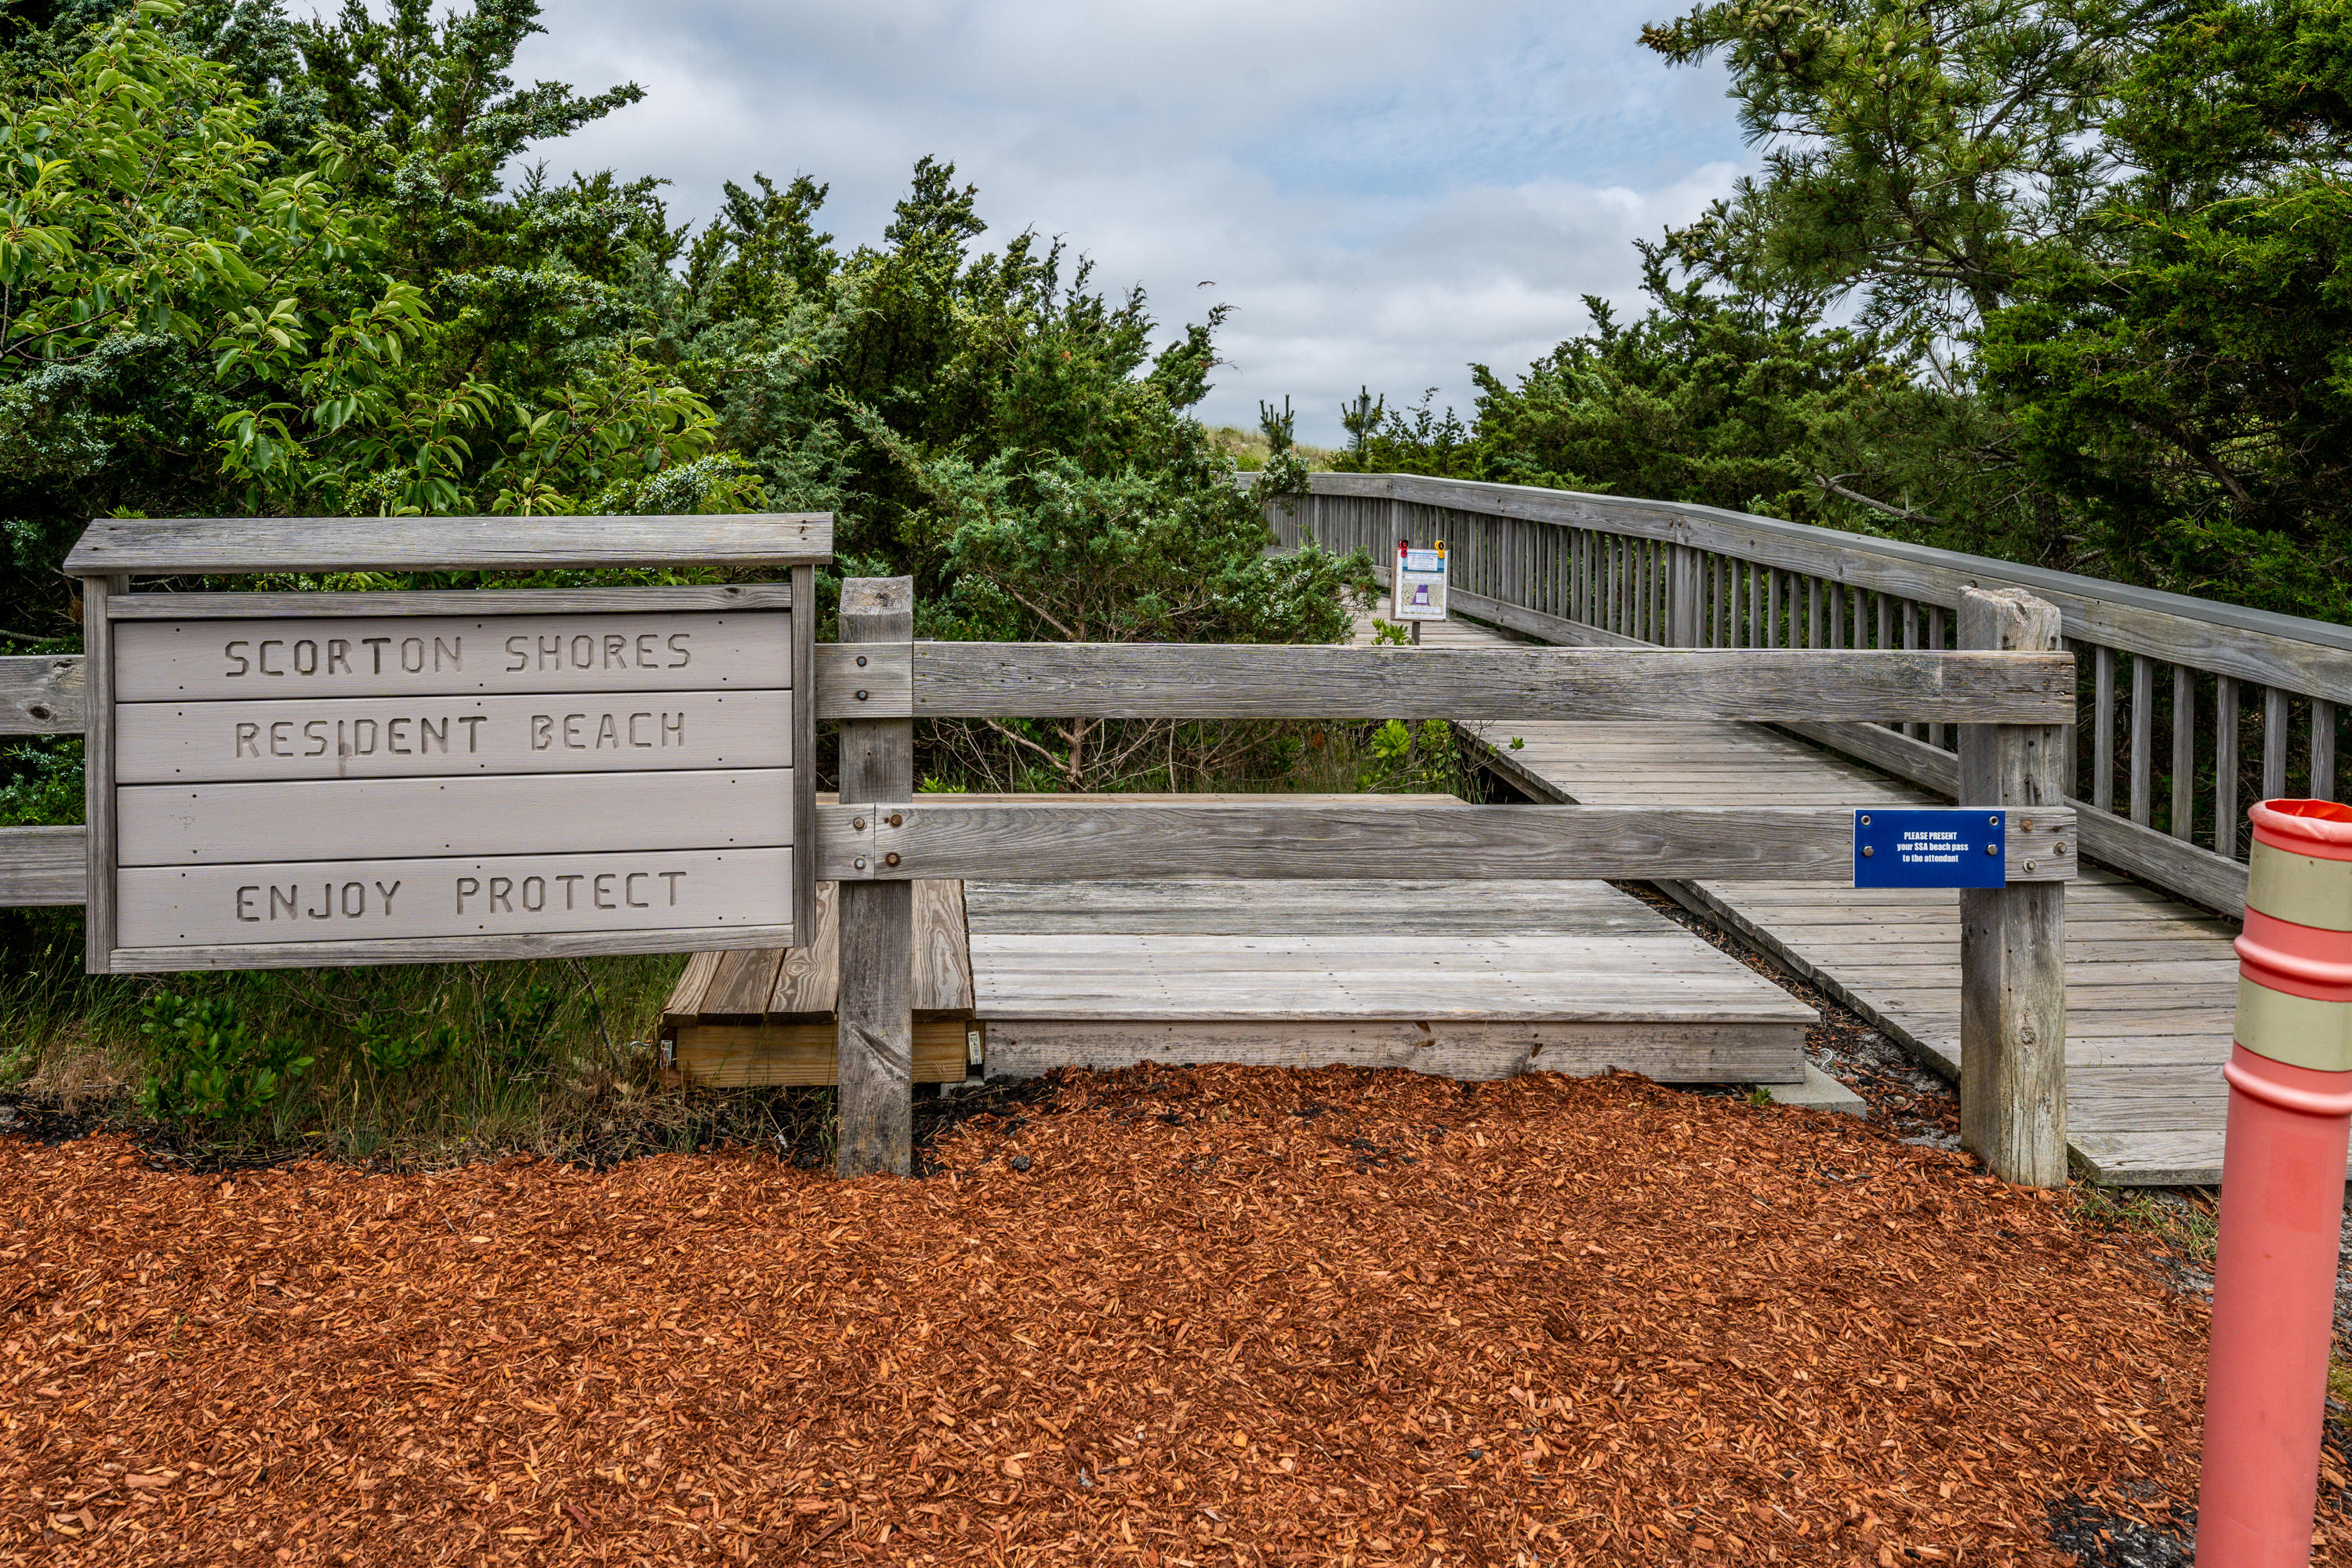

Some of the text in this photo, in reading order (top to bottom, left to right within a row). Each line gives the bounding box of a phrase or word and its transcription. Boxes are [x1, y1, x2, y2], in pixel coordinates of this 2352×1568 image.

[225, 633, 691, 677] SCORTON SHORES
[236, 711, 685, 759] RESIDENT BEACH
[236, 871, 687, 922] ENJOY PROTECT
